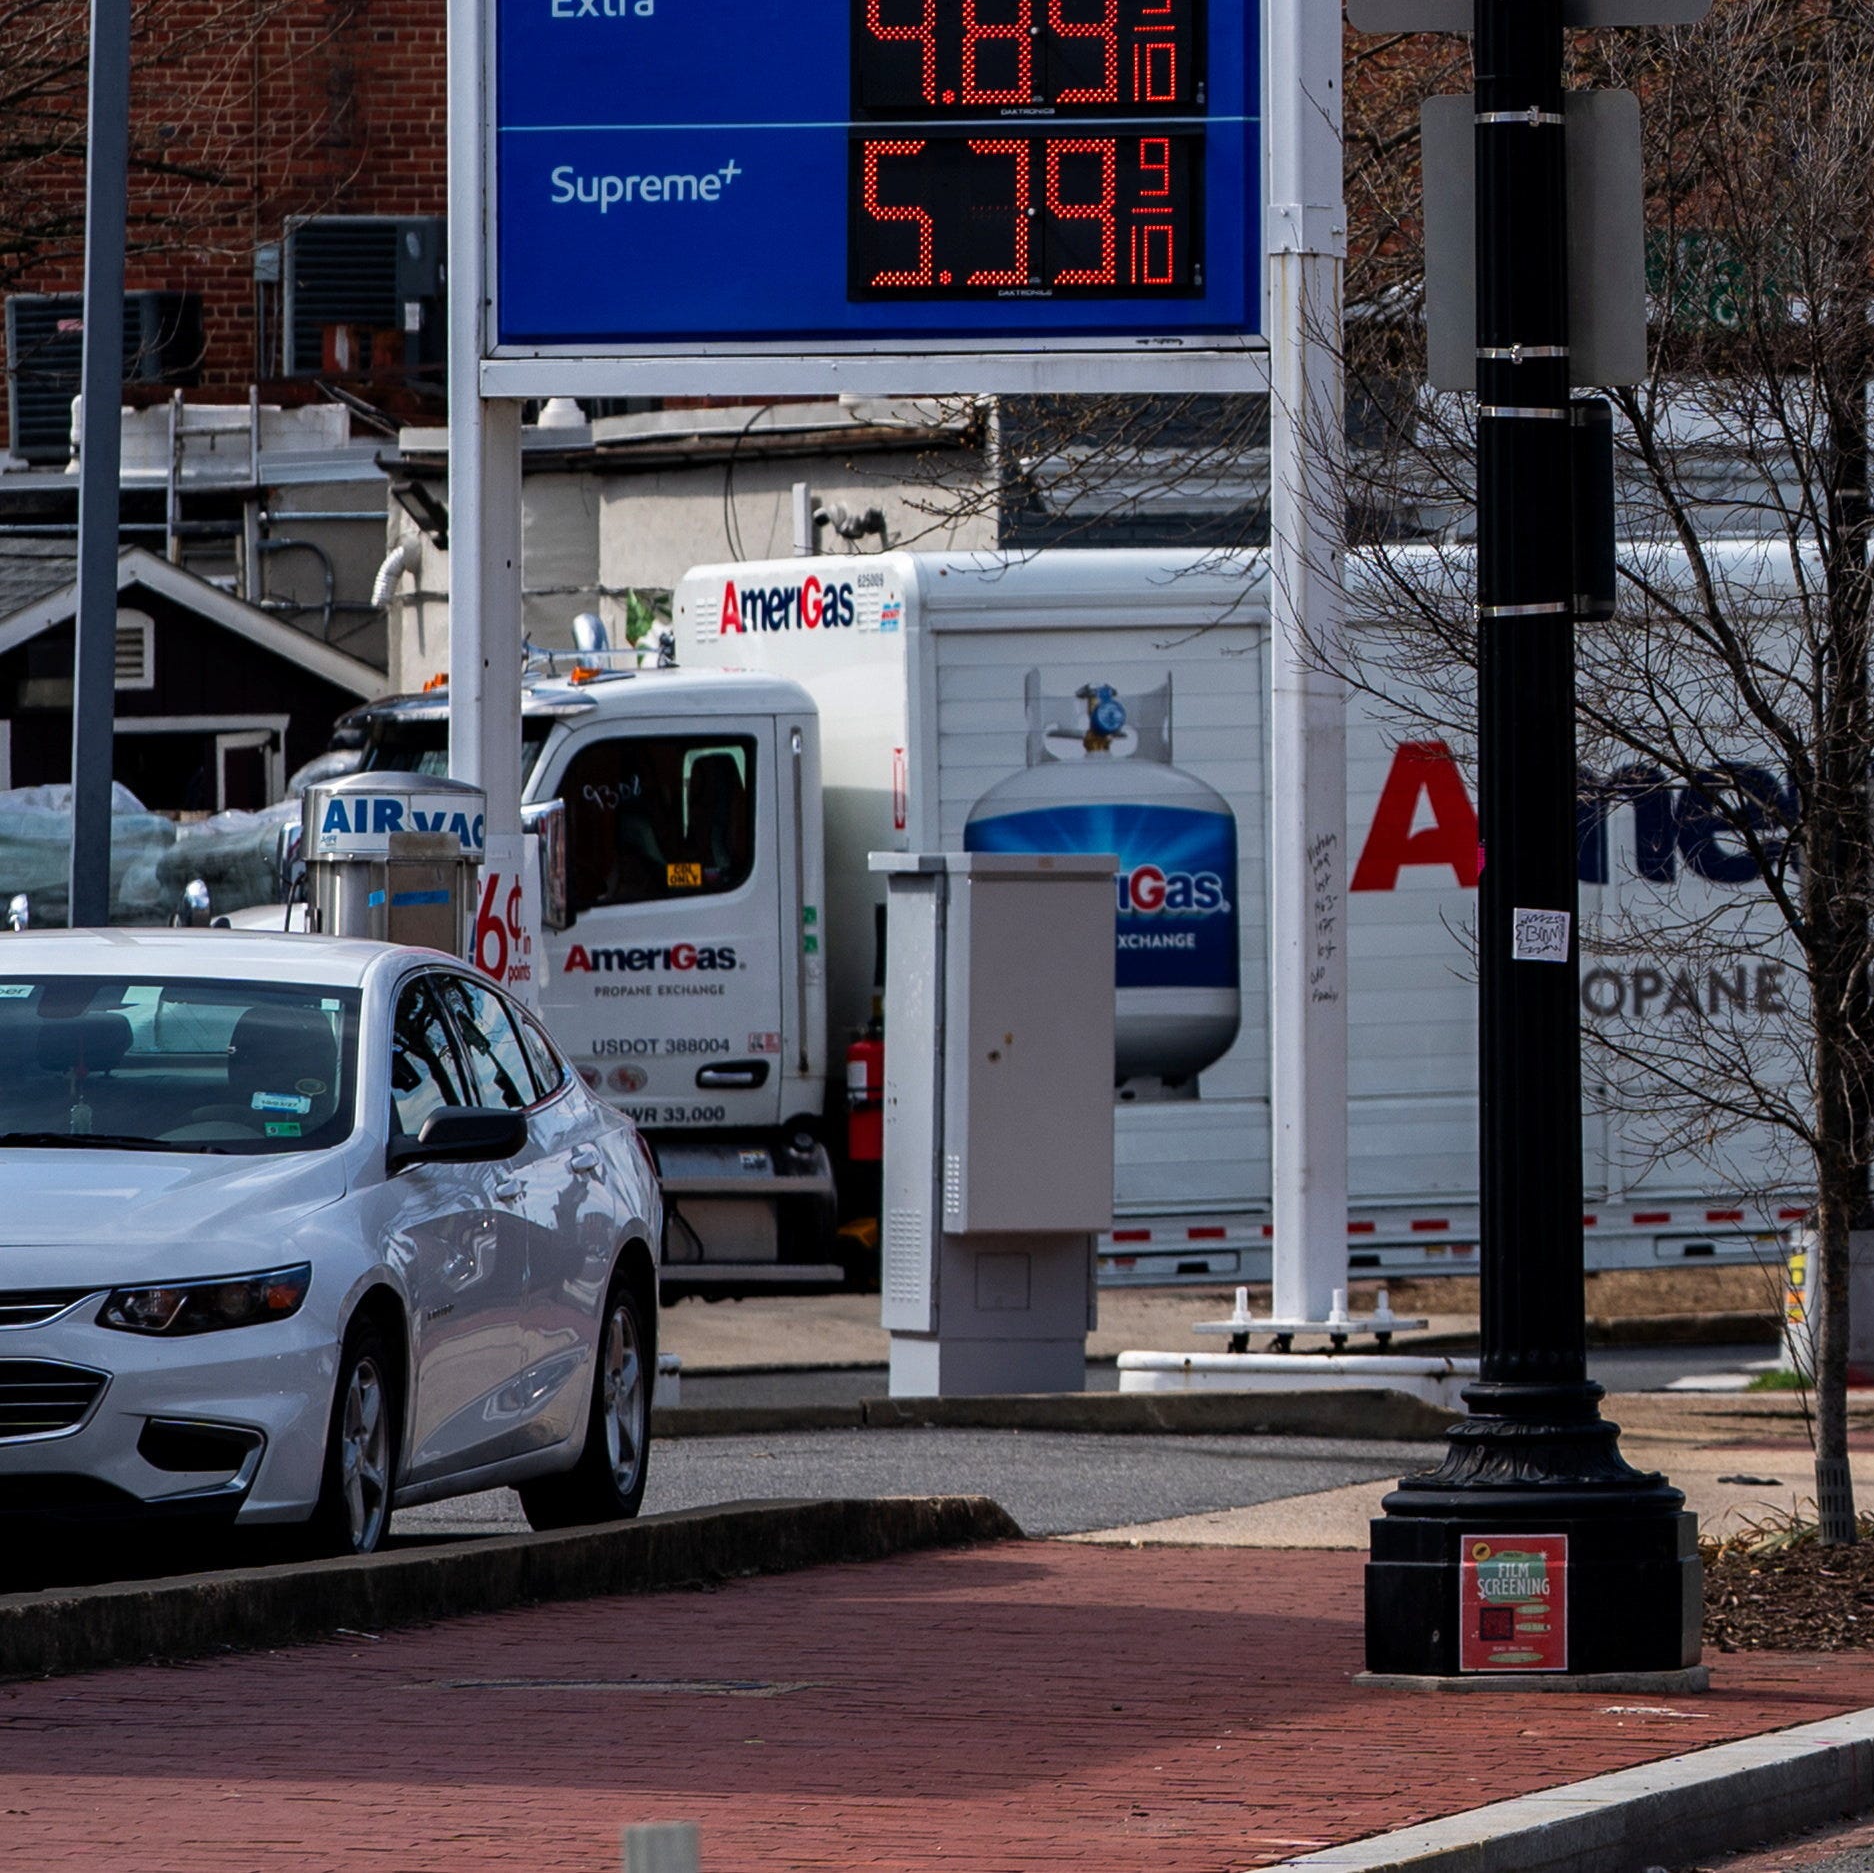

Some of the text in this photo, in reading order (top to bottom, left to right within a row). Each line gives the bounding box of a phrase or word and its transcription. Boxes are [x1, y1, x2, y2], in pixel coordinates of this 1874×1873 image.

[551, 159, 743, 213] Supreme+
[720, 575, 855, 635] AmeriGas
[322, 799, 406, 834] AIR
[674, 864, 694, 874] CDL
[669, 876, 699, 884] ONLY
[1115, 864, 1223, 914] iGas
[1117, 933, 1196, 949] XCHANGE
[564, 943, 737, 973] AmeriGas
[507, 959, 531, 987] points
[594, 984, 726, 997] PROPANE EXCHANGE
[1580, 964, 1786, 1016] OPANE
[592, 1039, 661, 1055] USDOT
[665, 1038, 730, 1054] 388004
[621, 1106, 658, 1123] WR
[1498, 1563, 1530, 1578] FILM
[1476, 1578, 1550, 1596] SCREENING
